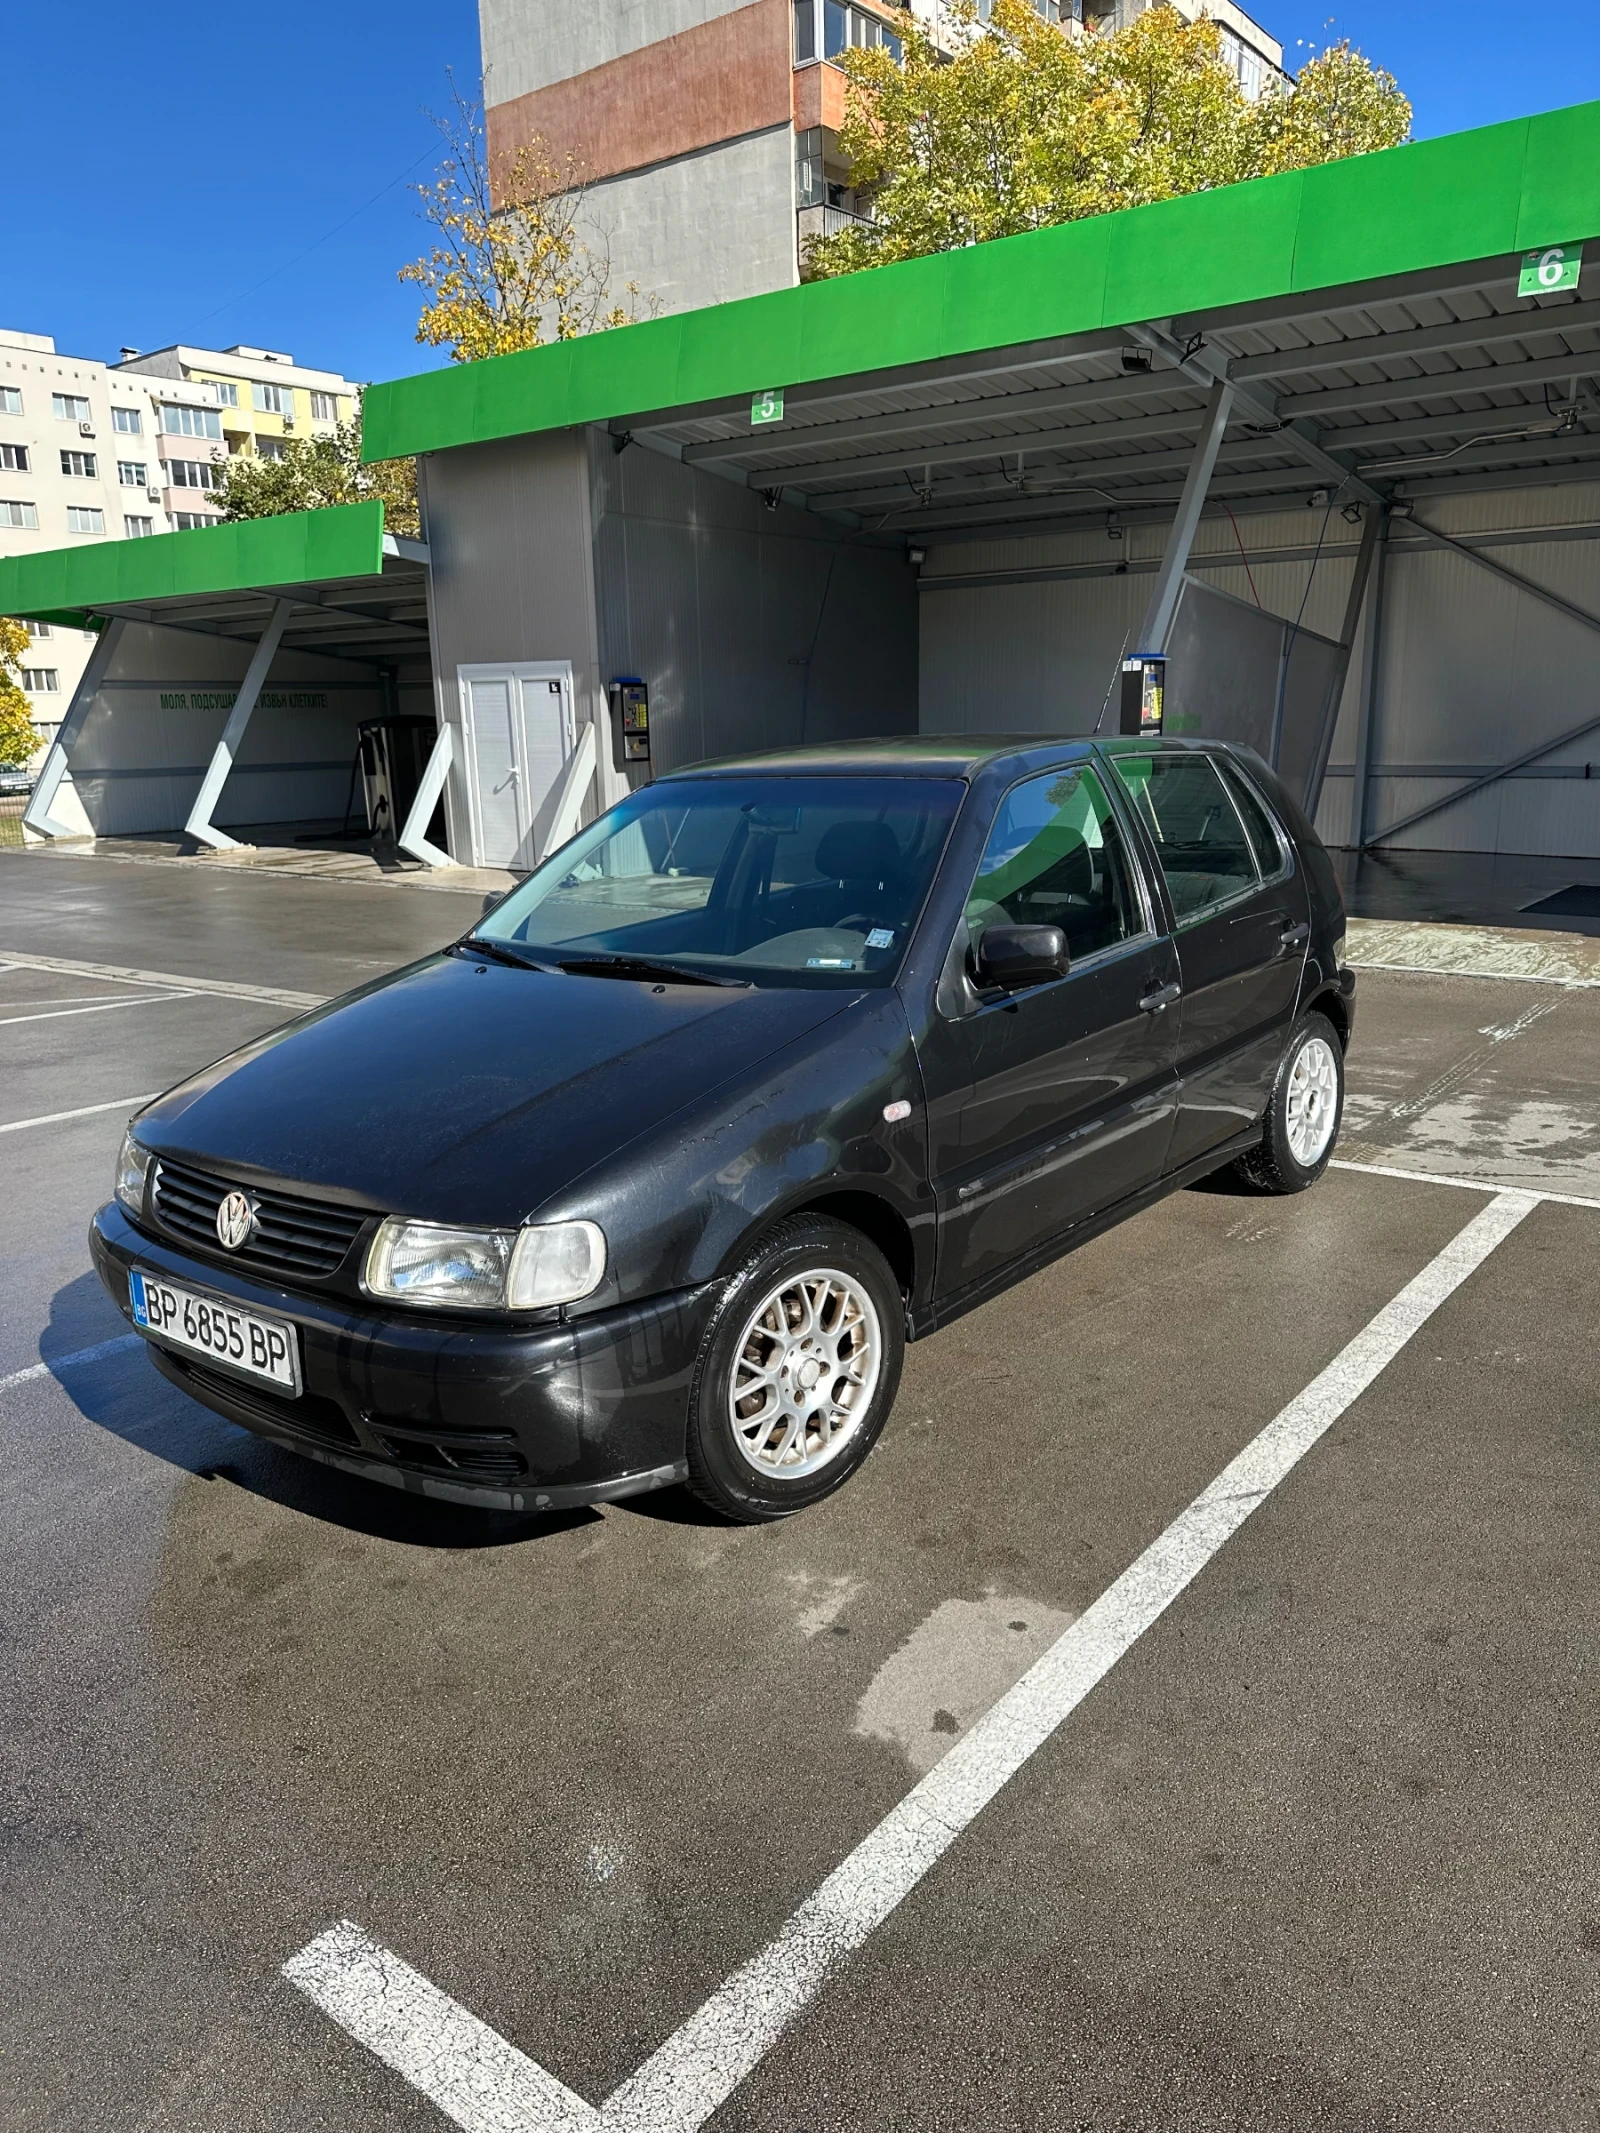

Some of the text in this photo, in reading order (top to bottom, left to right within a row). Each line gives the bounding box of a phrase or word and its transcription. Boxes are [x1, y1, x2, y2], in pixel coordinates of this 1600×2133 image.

[1538, 248, 1564, 286] 6
[761, 391, 775, 418] 5
[160, 693, 190, 711] МОЛЯ,
[260, 693, 287, 709] ИЗВЪН
[136, 1303, 147, 1319] BG
[145, 1281, 286, 1374] BP 6855 BP
